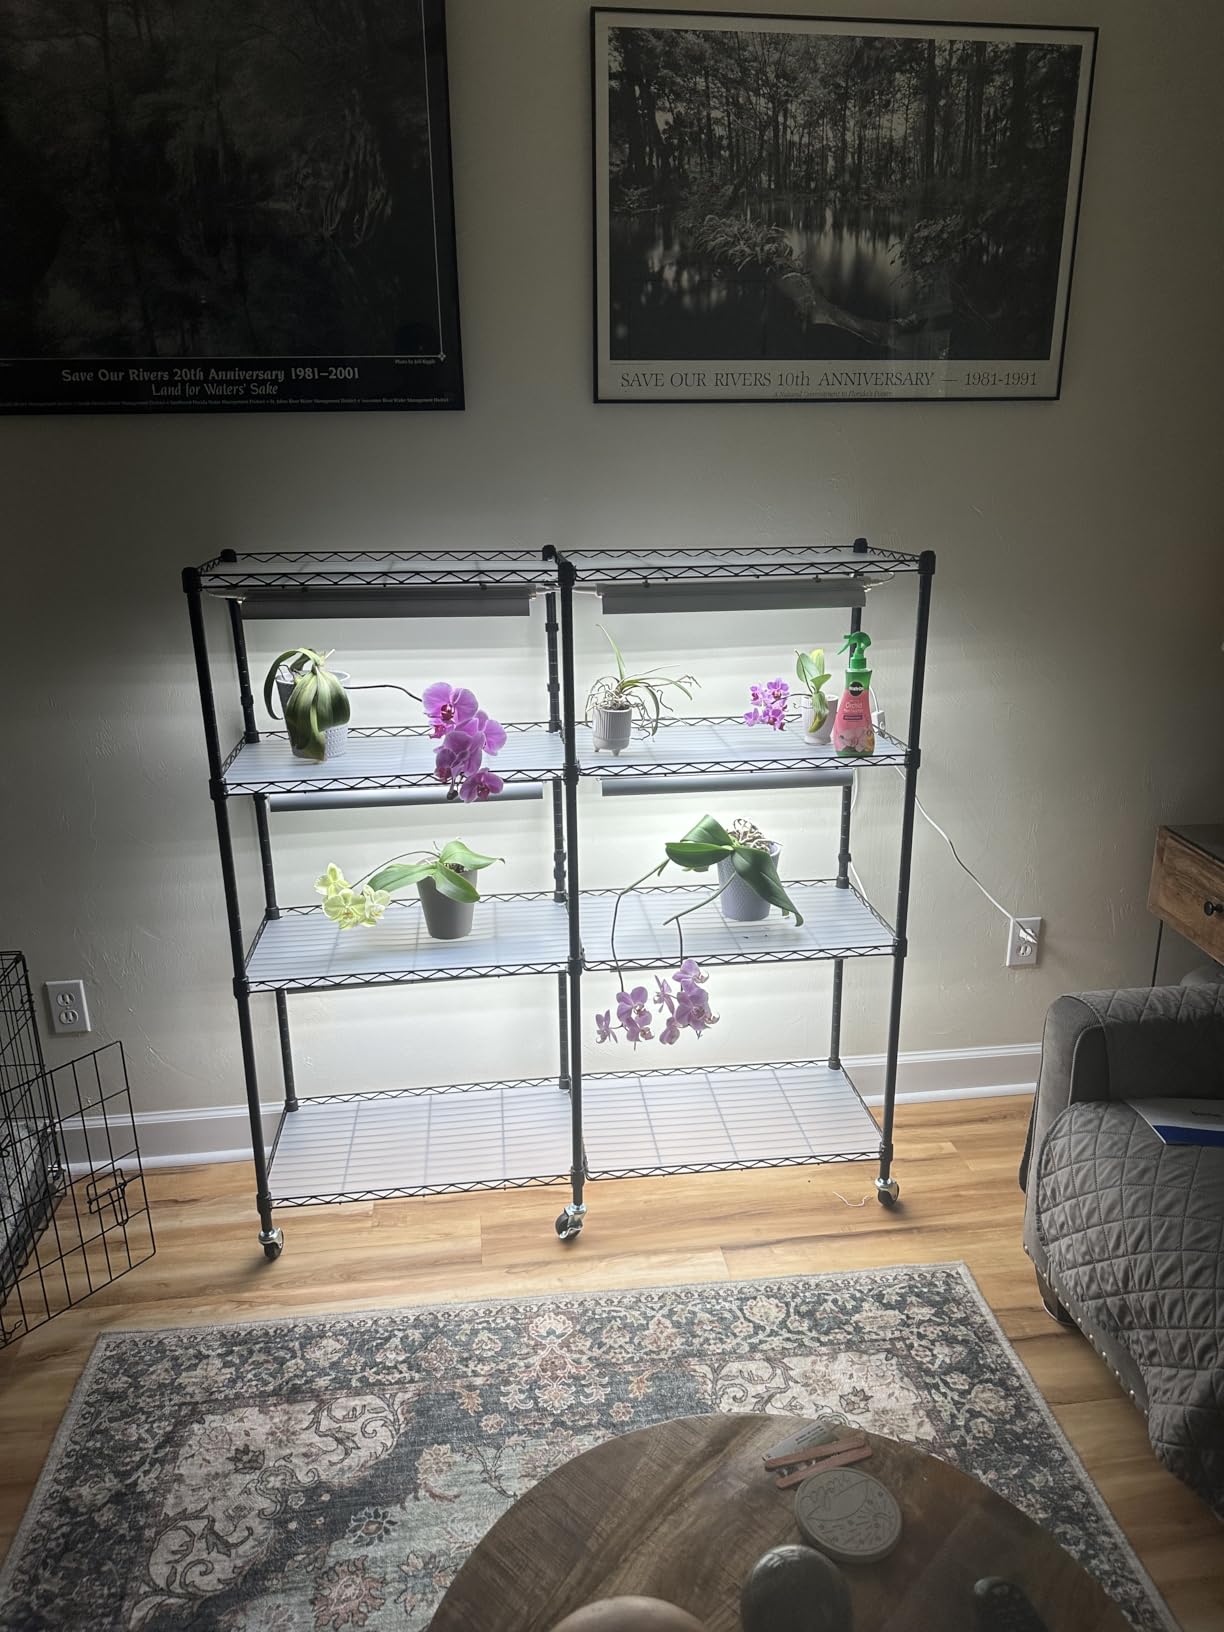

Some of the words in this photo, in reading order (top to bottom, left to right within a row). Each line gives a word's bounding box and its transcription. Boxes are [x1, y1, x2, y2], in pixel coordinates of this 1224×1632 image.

[61, 369, 94, 382] Save
[98, 369, 125, 382] Our
[128, 368, 169, 381] Rivers
[173, 367, 204, 381] 20th
[208, 368, 284, 382] Anniversary
[620, 372, 664, 387] SAVE
[670, 372, 707, 387] OUR
[714, 372, 772, 387] RIVERS
[778, 371, 810, 386] 10th
[818, 372, 935, 386] ANNIVERSARY
[964, 371, 1037, 386] 1981-1991
[151, 382, 181, 396] Land
[185, 382, 200, 397] for
[250, 381, 279, 395] Sake
[845, 701, 863, 709] Orchid
